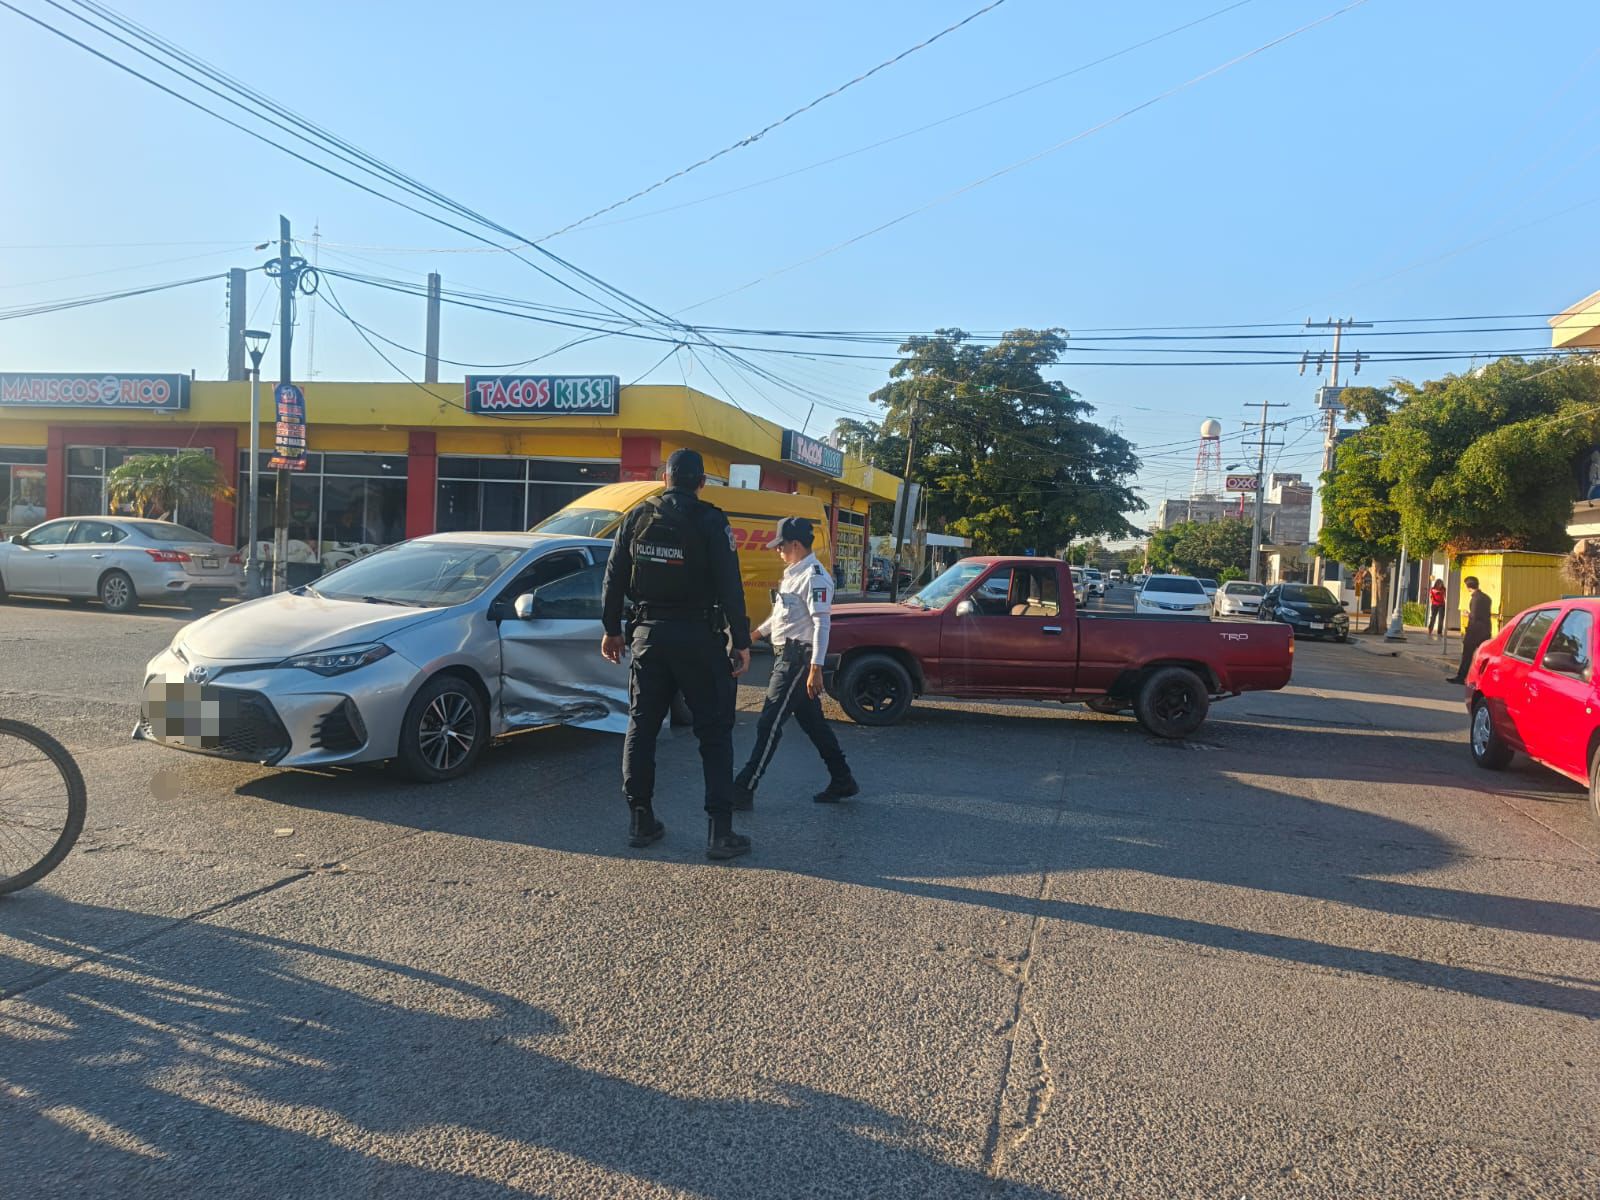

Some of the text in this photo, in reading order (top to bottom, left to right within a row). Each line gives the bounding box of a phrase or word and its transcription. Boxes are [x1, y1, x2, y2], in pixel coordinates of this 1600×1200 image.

[1, 376, 101, 402] MARISCOS
[119, 378, 171, 404] RICO
[477, 378, 612, 409] TACOS KISSI
[797, 435, 823, 465] TACOS
[655, 546, 684, 559] MUNICIPAL
[731, 527, 779, 551] DH
